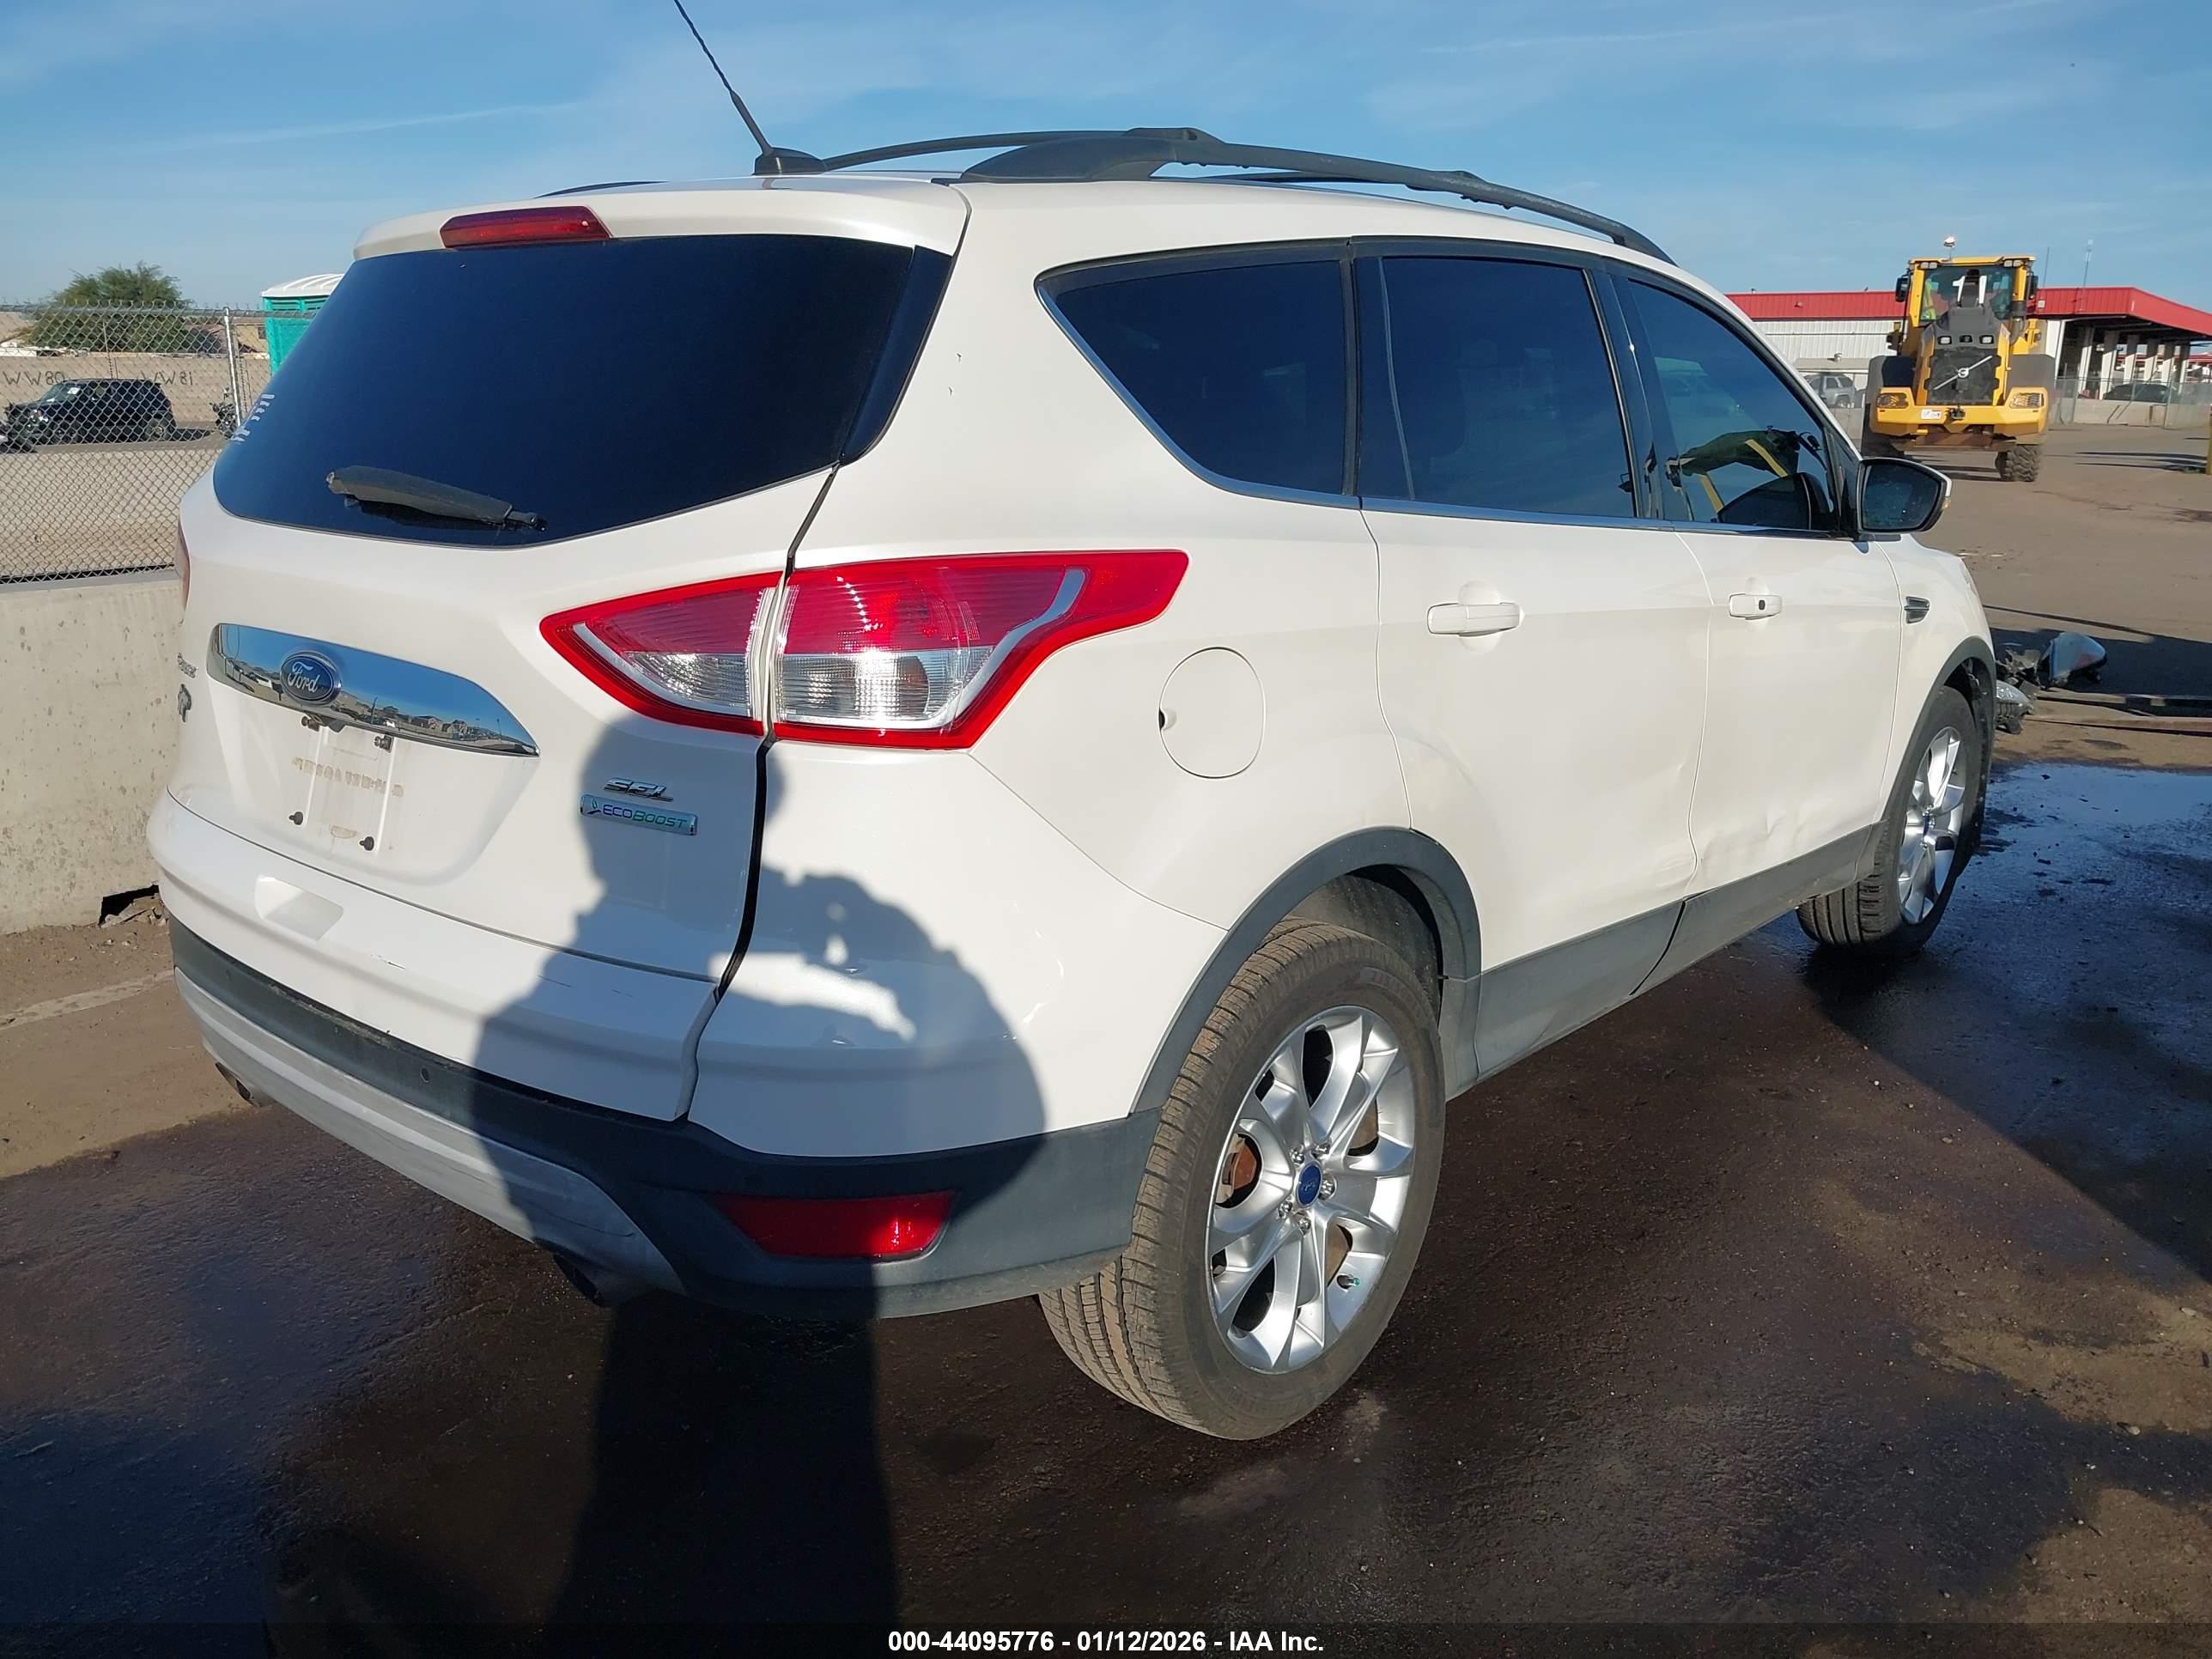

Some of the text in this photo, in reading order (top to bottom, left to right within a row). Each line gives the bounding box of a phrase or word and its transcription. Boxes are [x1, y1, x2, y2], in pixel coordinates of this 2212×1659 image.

[288, 661, 320, 693] Ford
[604, 777, 674, 802] SEL
[602, 804, 688, 829] ECOBOOST
